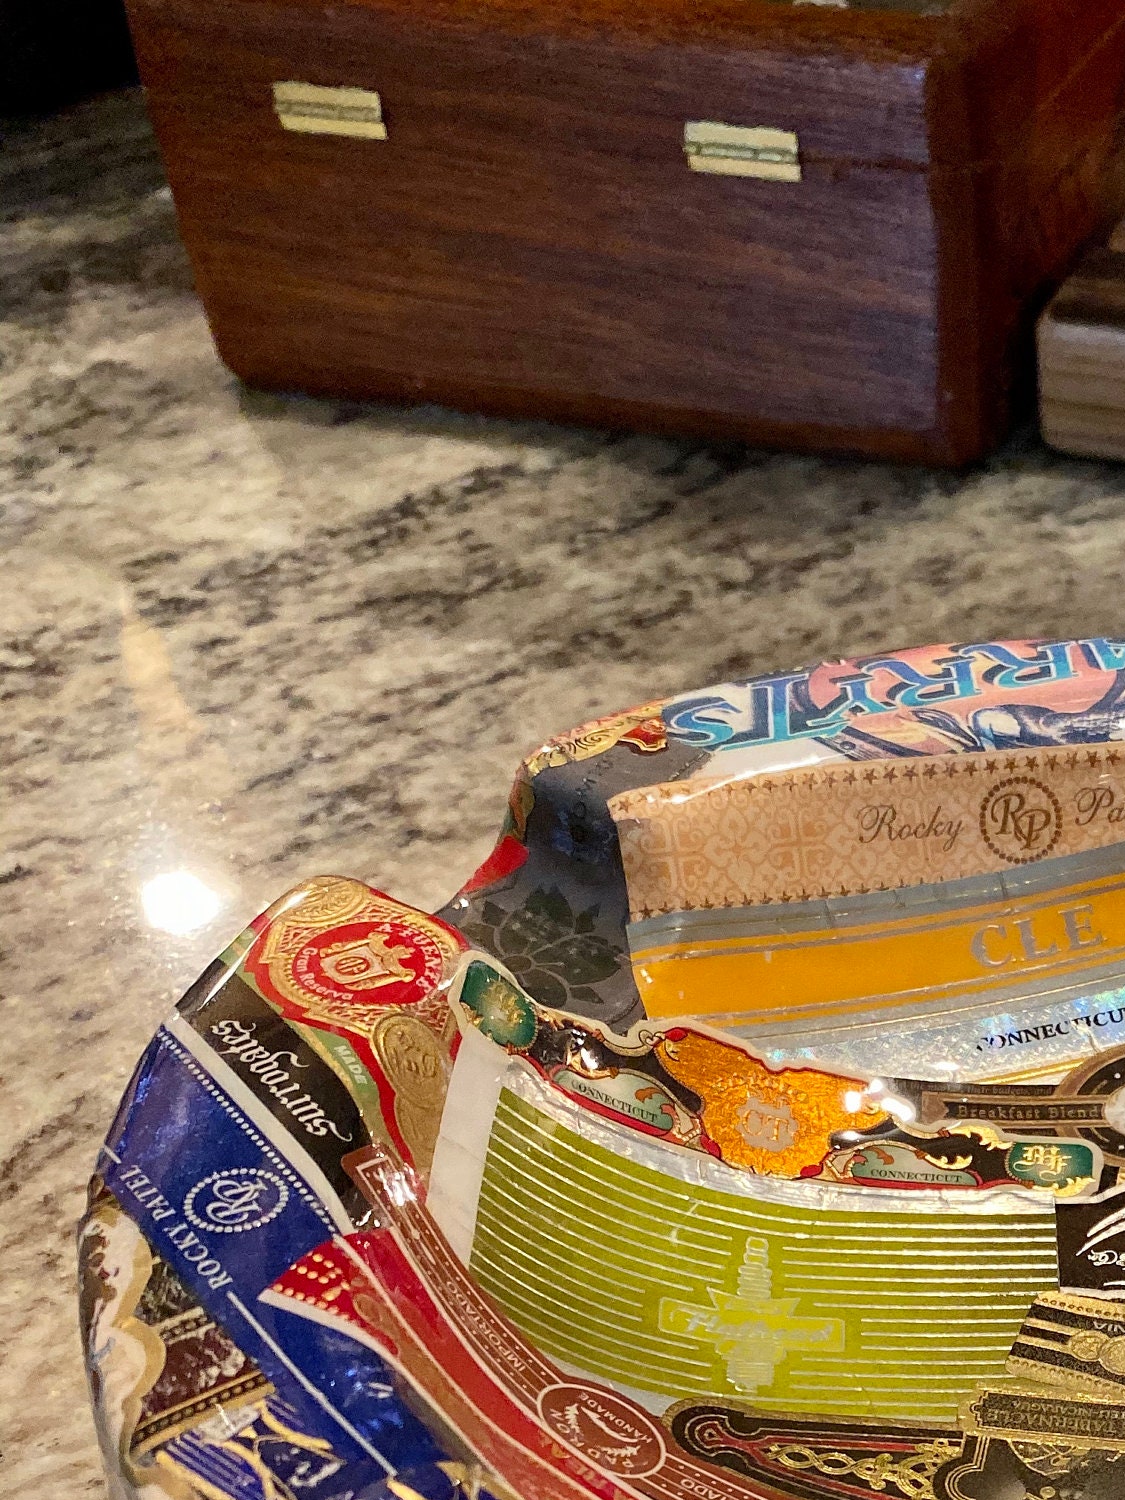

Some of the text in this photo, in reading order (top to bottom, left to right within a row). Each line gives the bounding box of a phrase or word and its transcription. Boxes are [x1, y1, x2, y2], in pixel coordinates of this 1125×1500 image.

[856, 804, 964, 852] Rocky
[971, 904, 1105, 968] CLE
[958, 1106, 1099, 1119] Breakfast Blend
[870, 1168, 963, 1183] CONNECTICUT
[120, 1164, 233, 1290] ROCKY PATEL
[444, 1277, 526, 1372] IMPORTADO
[578, 1391, 653, 1445] HANDMADE
[987, 1408, 1116, 1434] TABERNACLE
